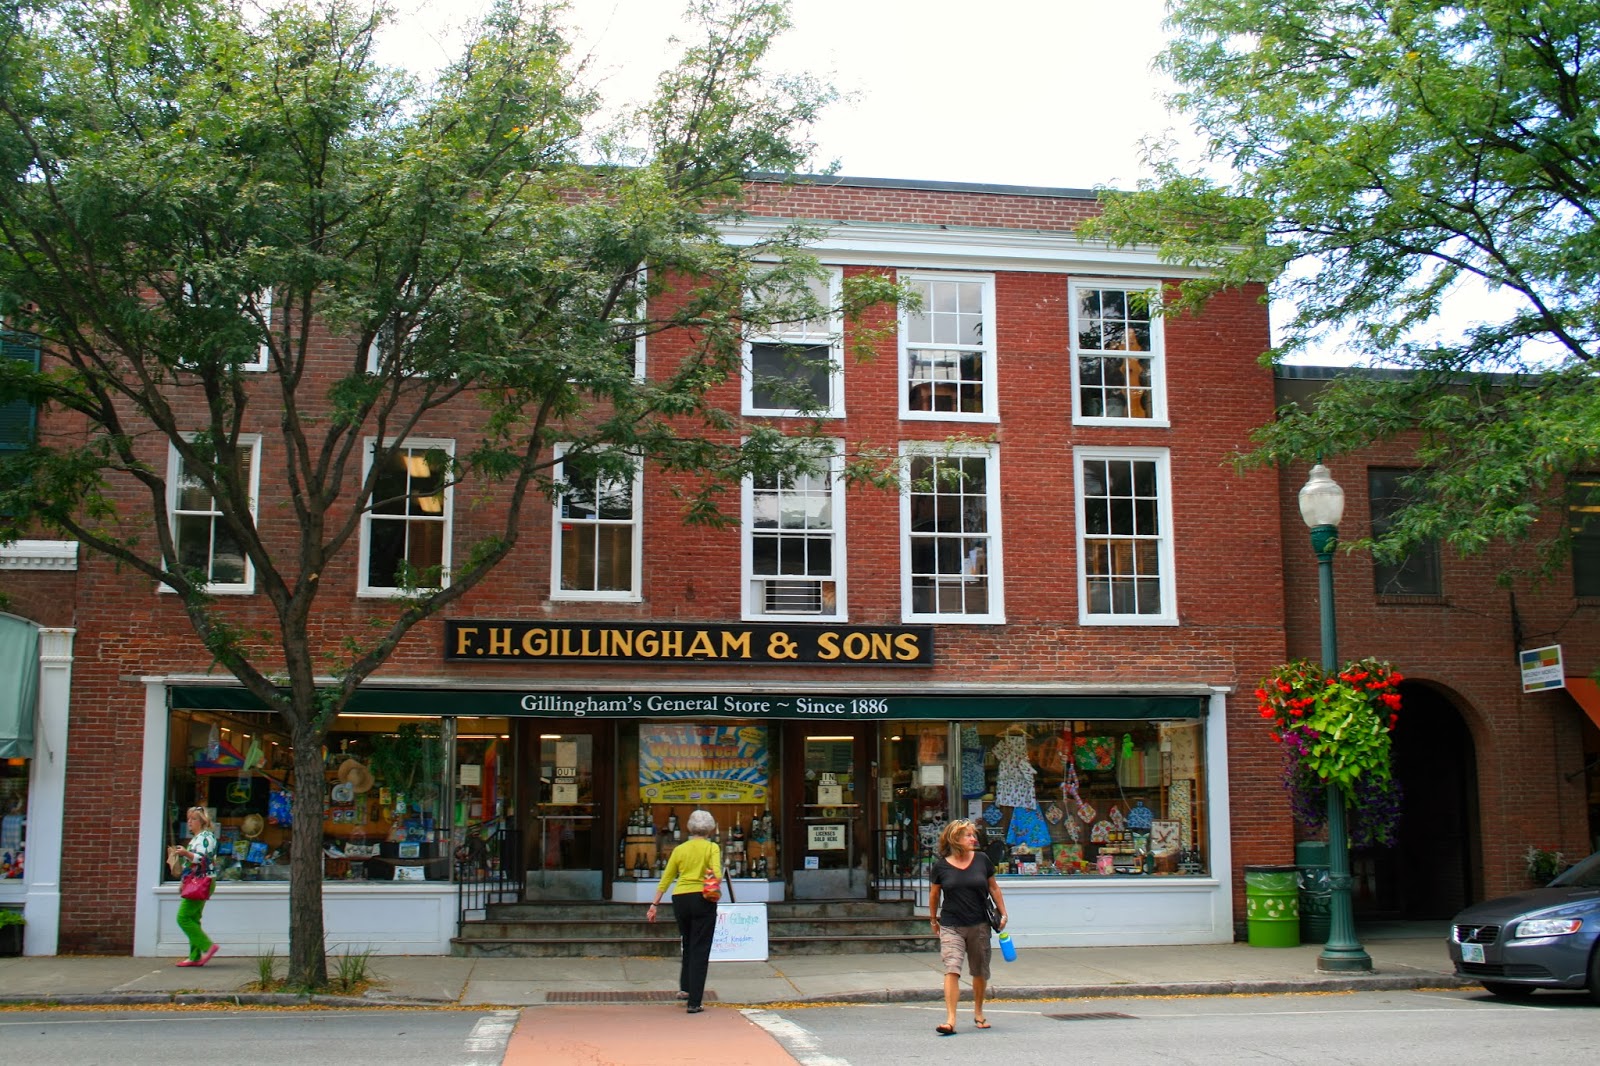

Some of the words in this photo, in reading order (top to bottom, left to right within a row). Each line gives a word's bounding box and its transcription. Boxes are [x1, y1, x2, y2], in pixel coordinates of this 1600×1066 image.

[766, 631, 798, 660] &
[817, 631, 920, 661] SONS
[520, 694, 642, 717] Gillingham's
[647, 695, 718, 711] General
[723, 696, 770, 713] Store
[796, 698, 845, 714] Since
[849, 698, 888, 714] 1886
